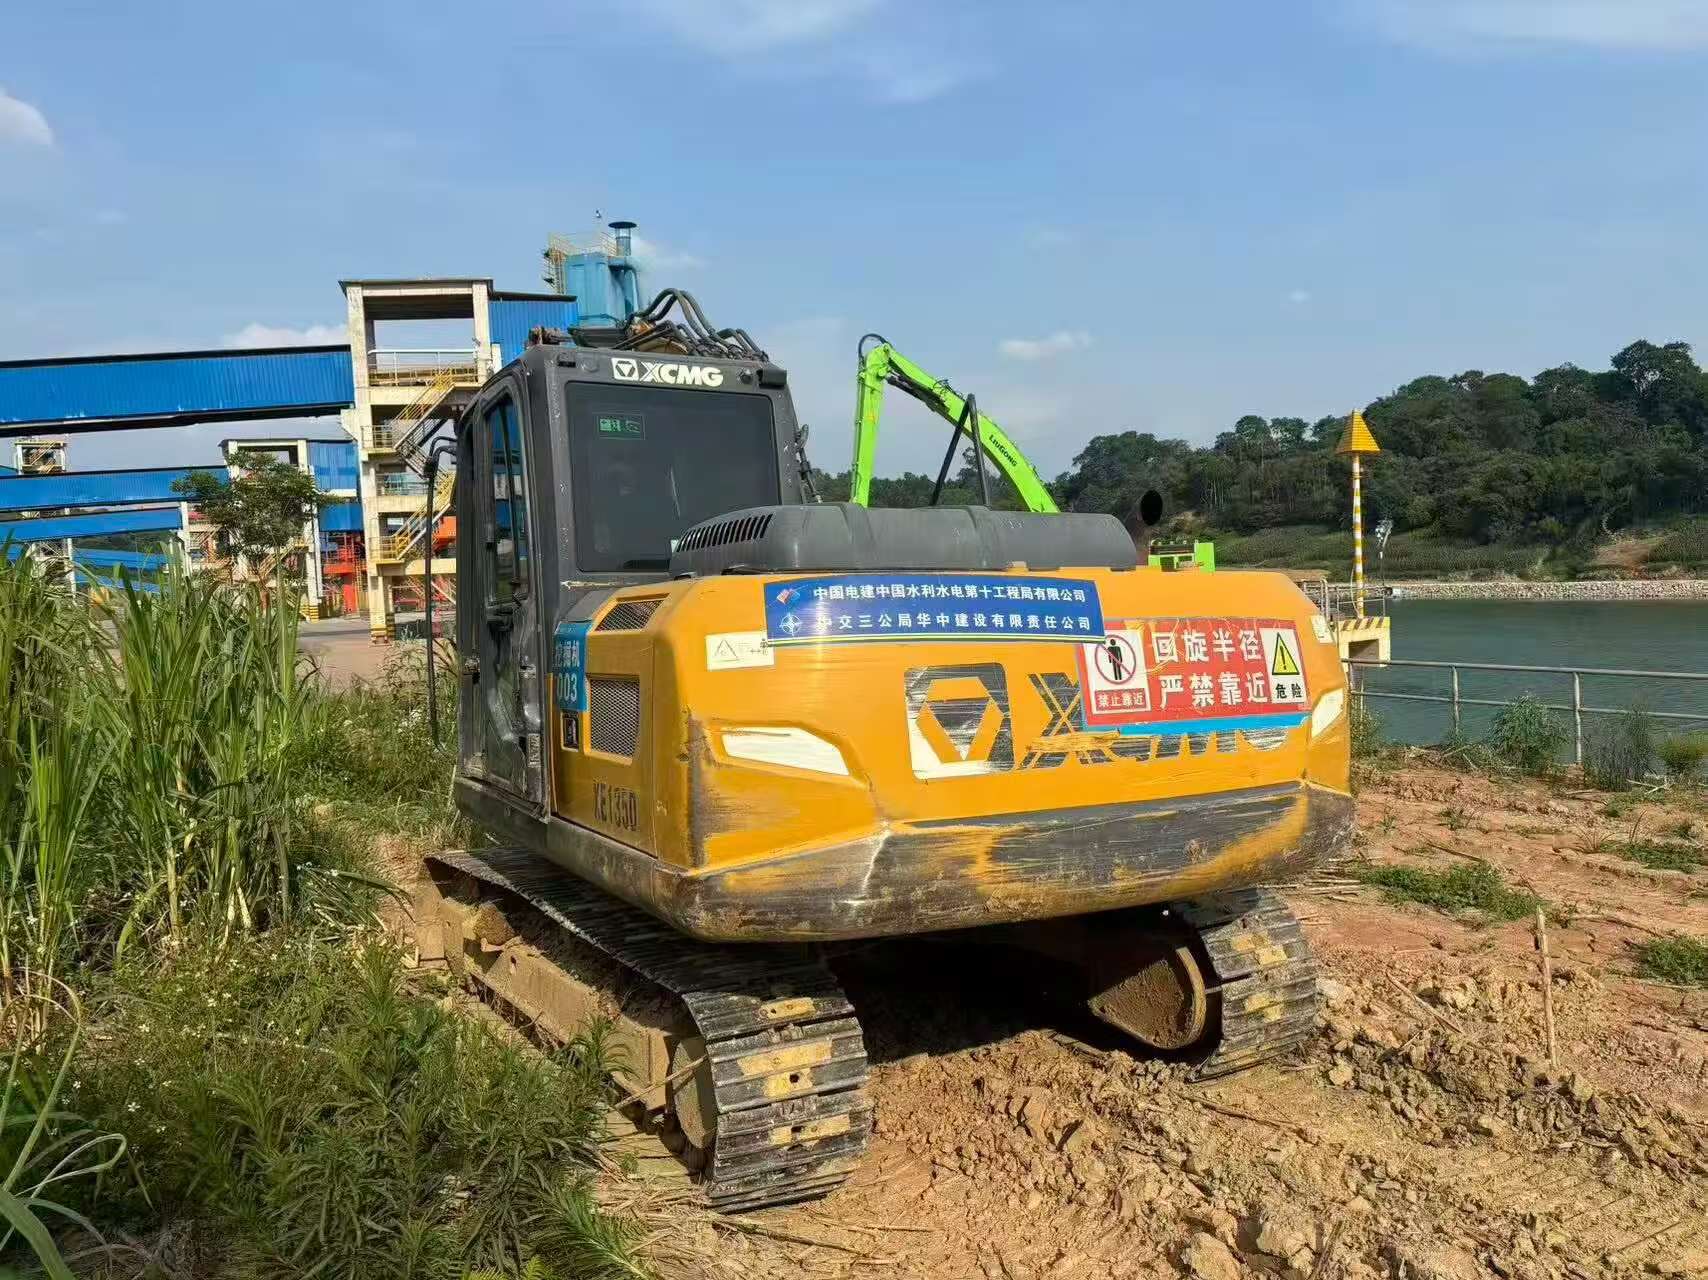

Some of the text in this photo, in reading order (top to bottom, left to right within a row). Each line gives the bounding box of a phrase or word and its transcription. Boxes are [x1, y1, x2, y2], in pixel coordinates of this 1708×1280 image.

[640, 361, 724, 387] XCMG
[813, 584, 1086, 603] 中国电建中国水利水电第十工程局有限公司
[1152, 629, 1263, 664] 回旋半径
[1097, 690, 1144, 708] 禁止靠近
[1159, 671, 1268, 708] 严禁靠近
[1275, 683, 1302, 699] 危险
